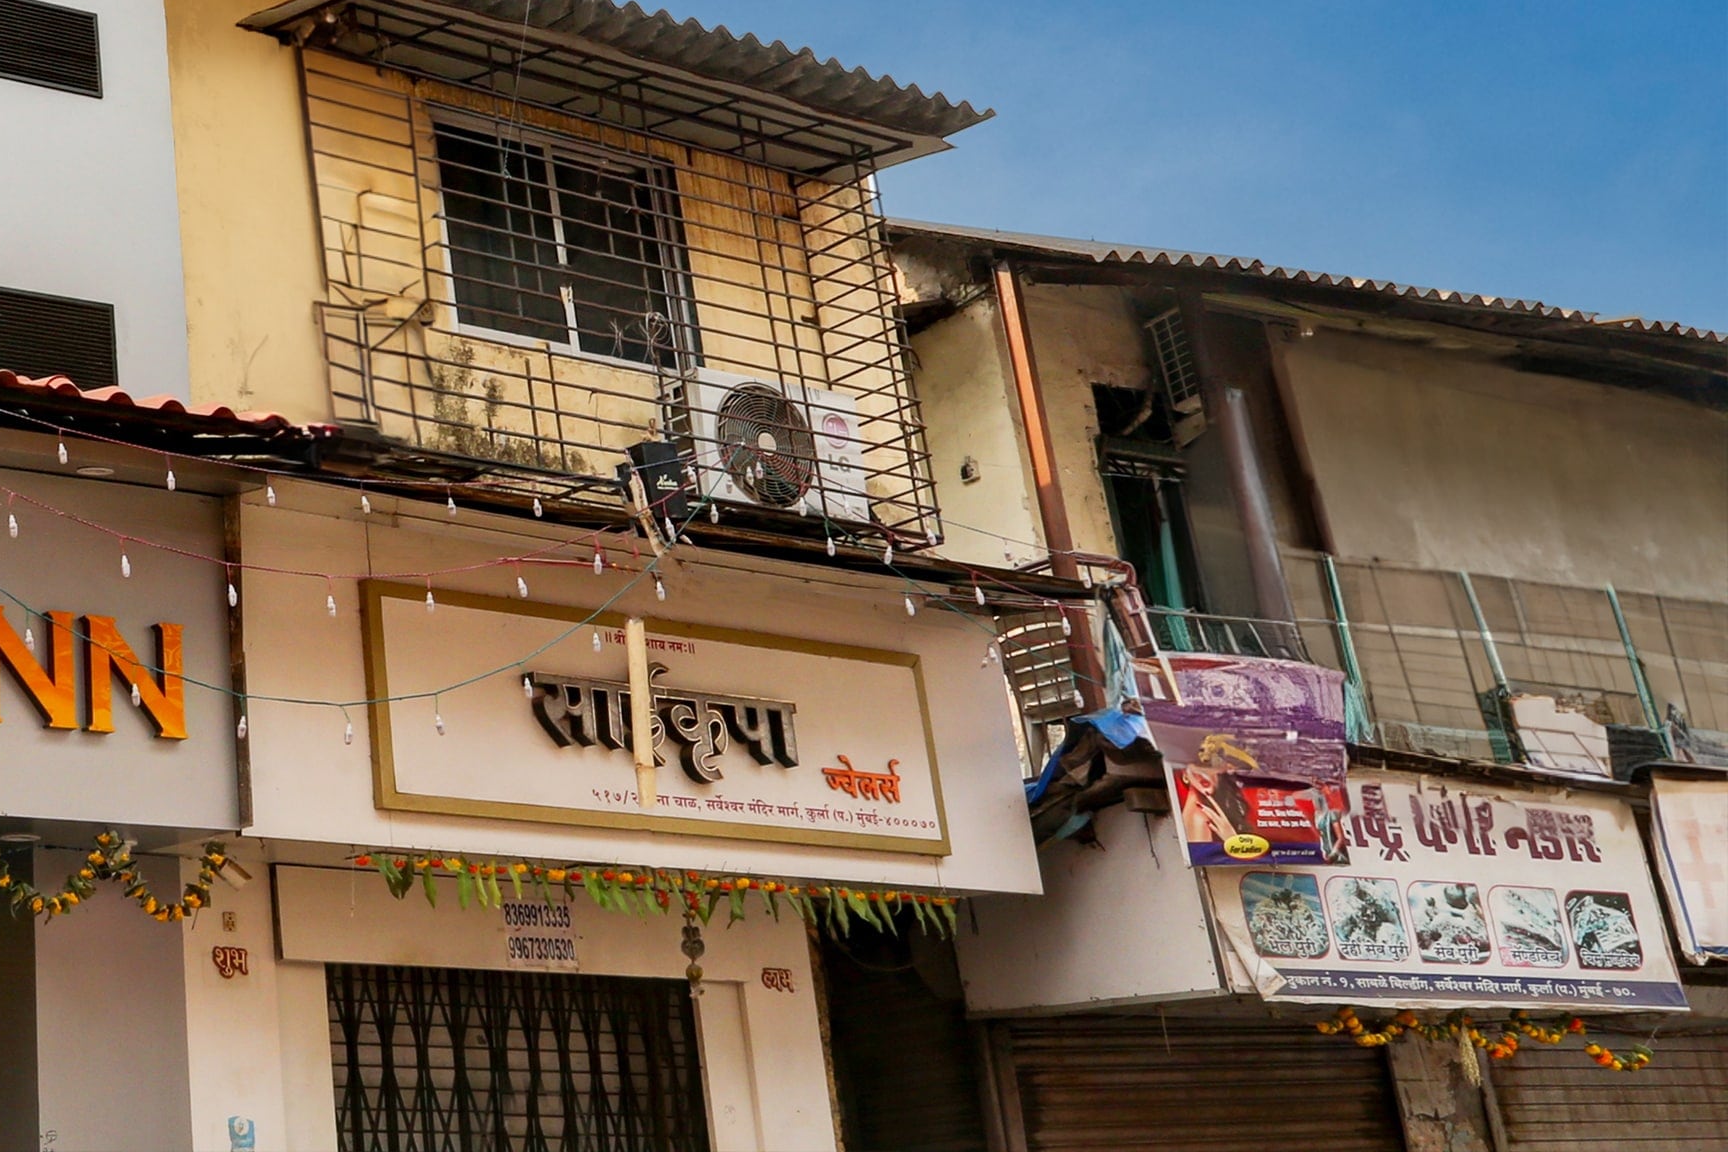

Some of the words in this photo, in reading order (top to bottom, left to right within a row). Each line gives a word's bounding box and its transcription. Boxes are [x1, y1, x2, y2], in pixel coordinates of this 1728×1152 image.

[828, 454, 852, 473] LG
[508, 936, 575, 961] 9967330530
[212, 945, 248, 979] शुभ
[761, 967, 795, 994] लाभ
